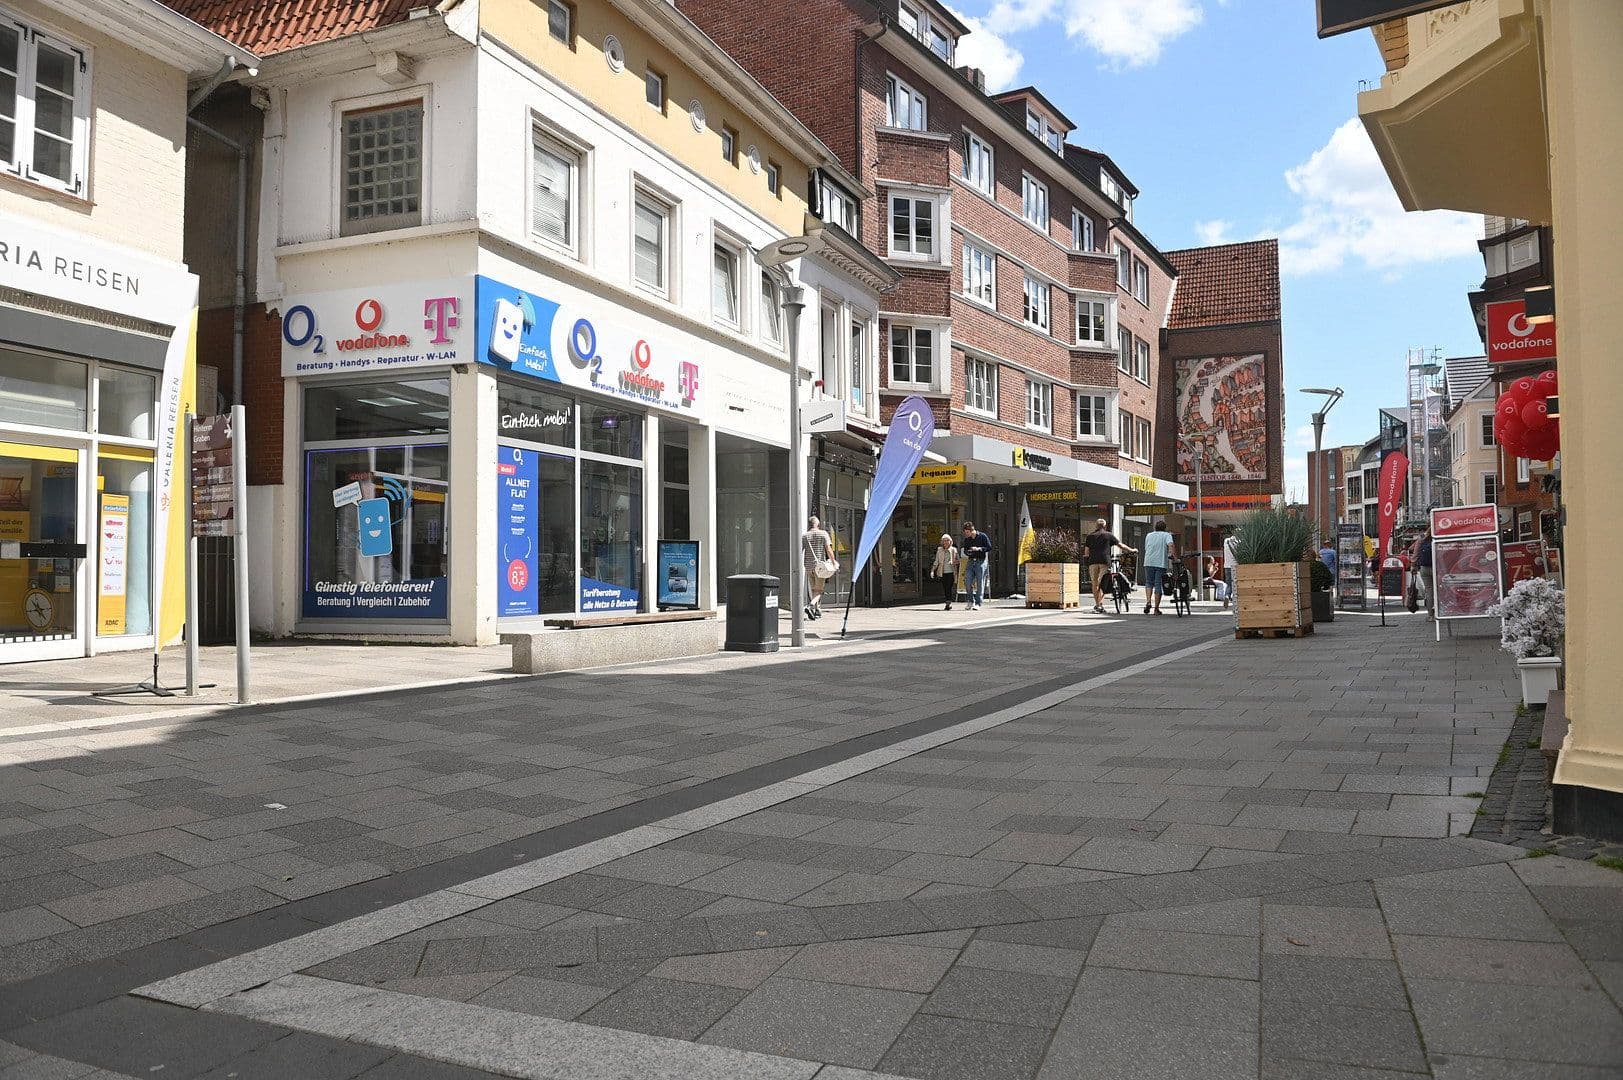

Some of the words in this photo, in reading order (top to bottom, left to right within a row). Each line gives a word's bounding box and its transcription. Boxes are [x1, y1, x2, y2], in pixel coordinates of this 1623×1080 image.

[55, 256, 140, 295] REISEN
[283, 305, 324, 353] O2
[336, 332, 408, 351] vodafone
[1492, 338, 1553, 350] vodafone
[519, 342, 547, 360] Einfach
[296, 360, 334, 371] Beratung
[340, 358, 371, 367] Handys
[377, 354, 419, 364] Reparatur
[426, 351, 456, 360] W-LAN
[623, 370, 665, 392] vodafone
[168, 377, 180, 422] REISEN
[502, 412, 542, 428] Einfach
[909, 410, 923, 438] O2
[193, 435, 211, 443] Graben
[903, 438, 914, 448] can
[505, 477, 531, 488] ALLNET
[1389, 460, 1398, 499] vodafone
[511, 488, 527, 499] FLAT
[1453, 516, 1491, 526] vodafone
[315, 580, 357, 596] Günstig
[359, 579, 434, 594] Telefonieren!
[583, 588, 621, 598] Tarifberatung
[317, 597, 351, 608] Beratung
[357, 597, 392, 607] Vergleich
[398, 597, 431, 606] Zubehör
